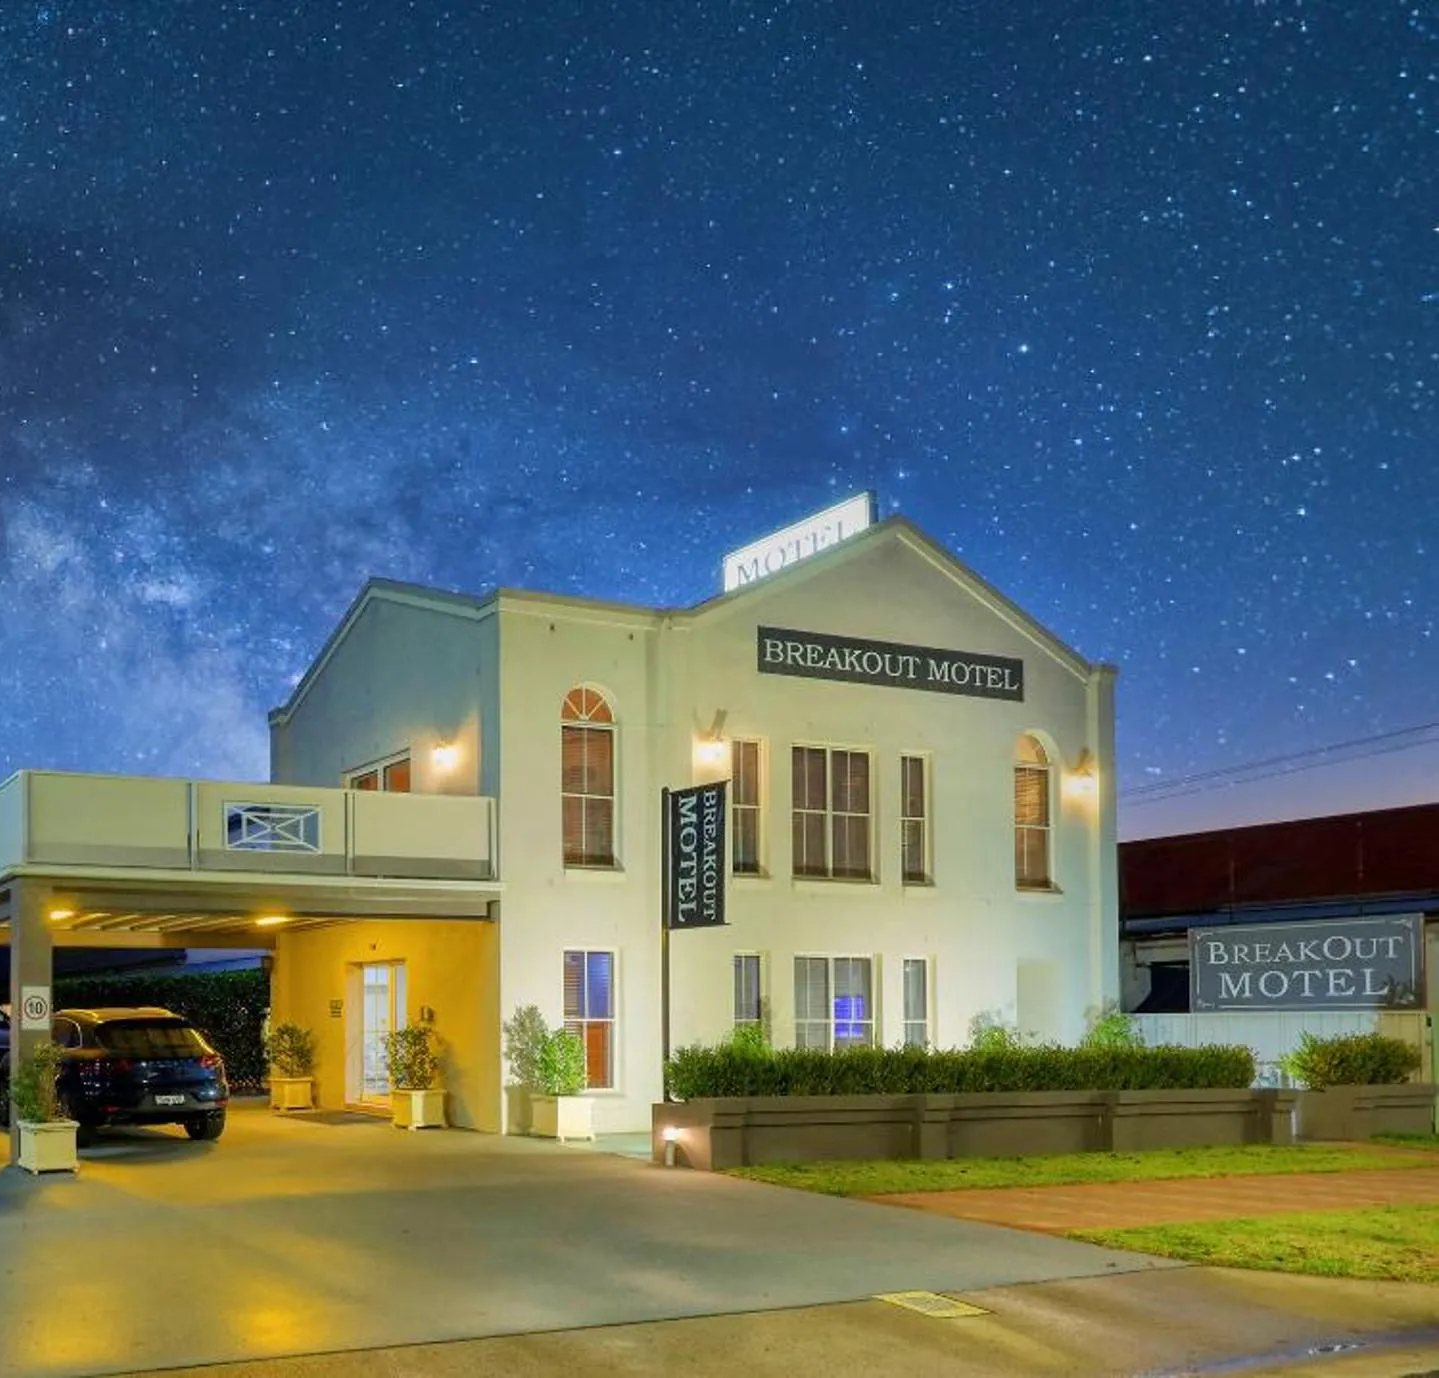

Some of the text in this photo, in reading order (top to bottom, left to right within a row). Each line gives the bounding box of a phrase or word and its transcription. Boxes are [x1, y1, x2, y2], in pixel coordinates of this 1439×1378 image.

[763, 638, 1021, 692] BREAKOUT MOTEL
[678, 793, 697, 922] MOTEL
[702, 790, 717, 921] BREAKOUT
[1218, 968, 1389, 999] MOTEL
